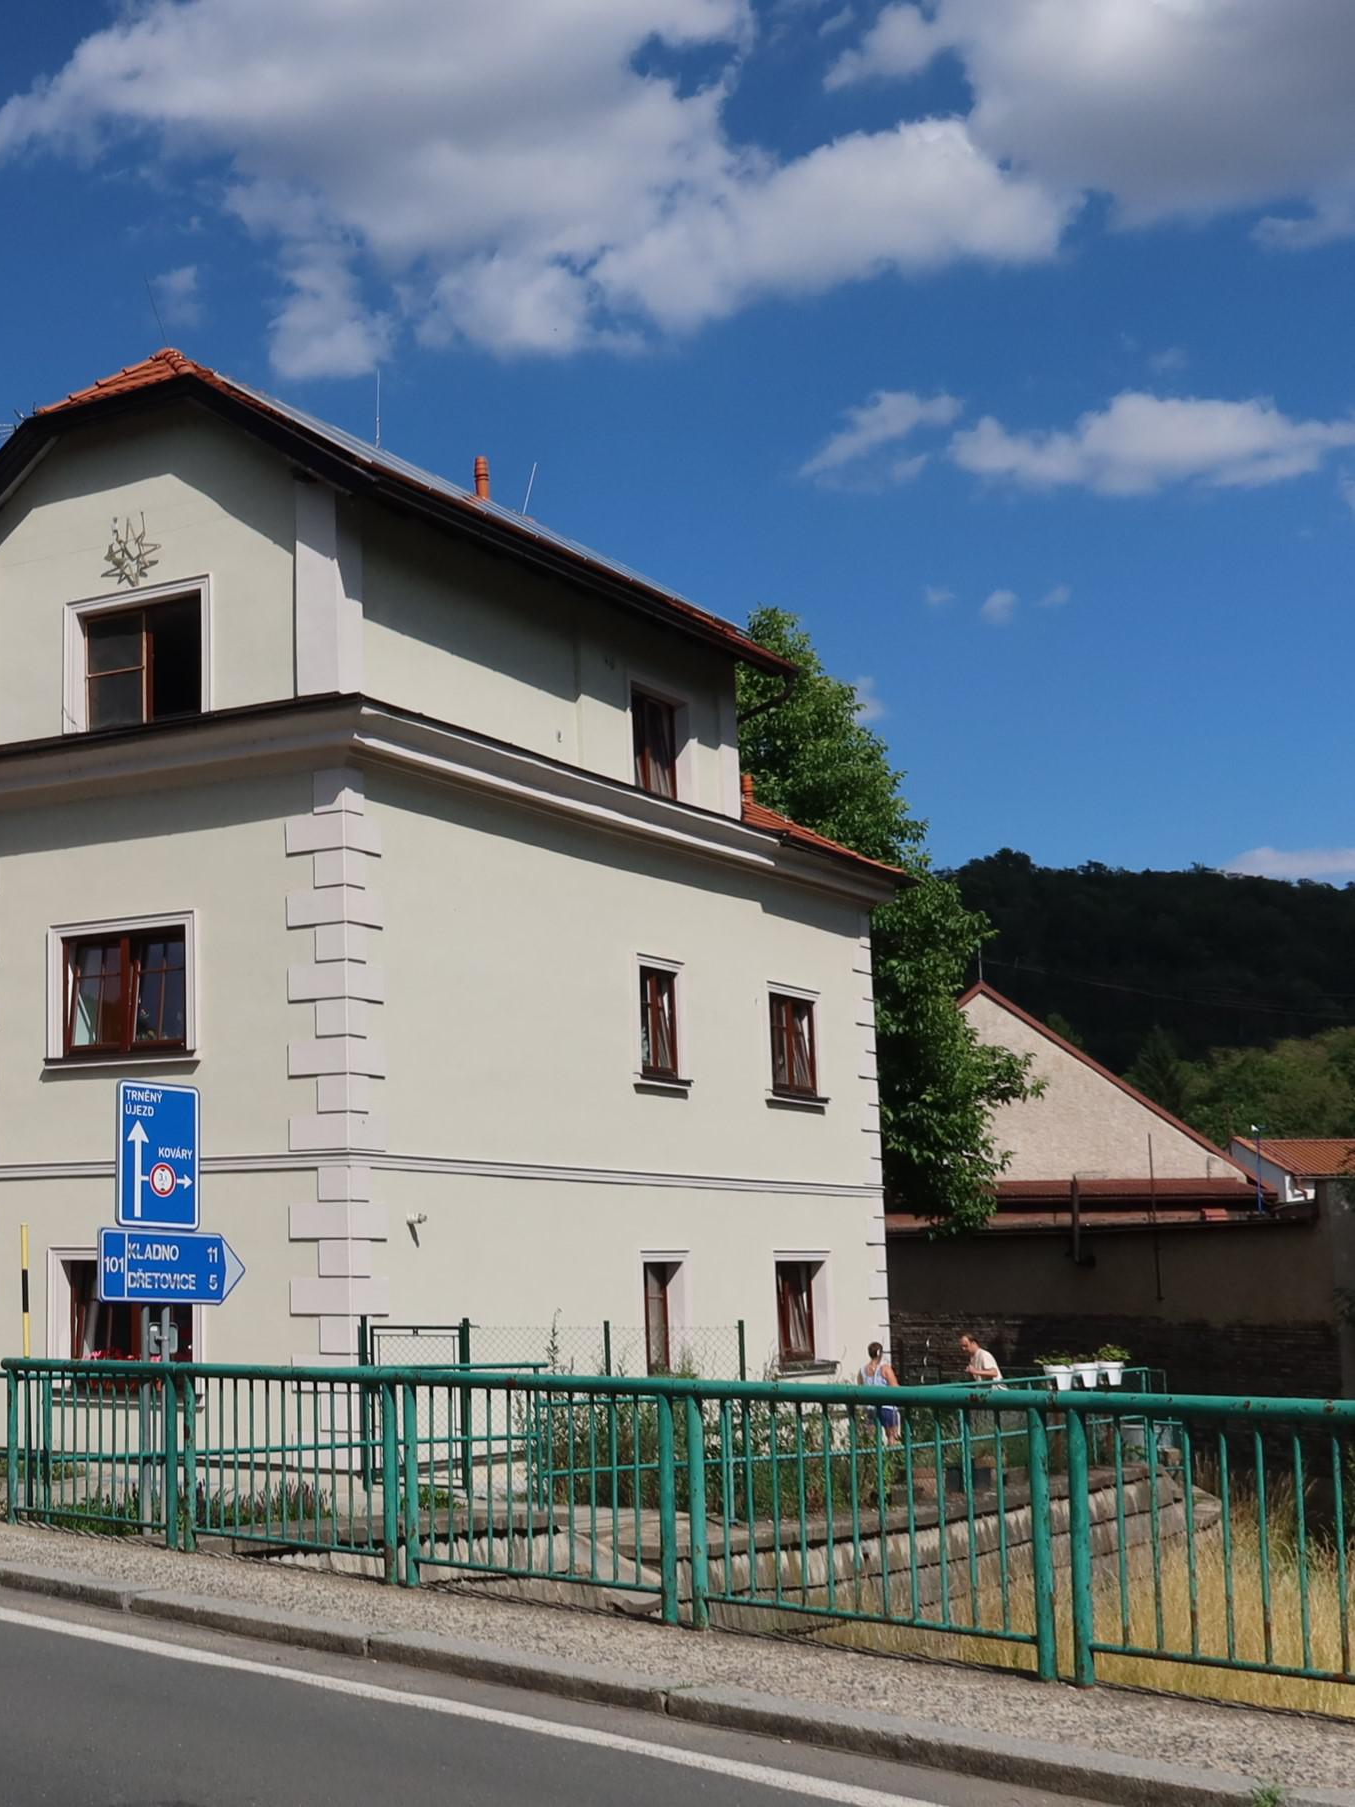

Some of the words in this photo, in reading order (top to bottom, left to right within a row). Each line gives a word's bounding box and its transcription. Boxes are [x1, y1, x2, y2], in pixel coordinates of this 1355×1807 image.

[125, 1089, 163, 1103] TRNĚNÝ
[125, 1102, 155, 1117] ÚJEZD
[158, 1146, 193, 1160] KOVÁRY
[128, 1242, 180, 1261] KLADNO
[207, 1247, 218, 1264] 11
[104, 1256, 124, 1273] 101
[127, 1268, 196, 1290] DŘETOVICE
[208, 1274, 218, 1291] 5
